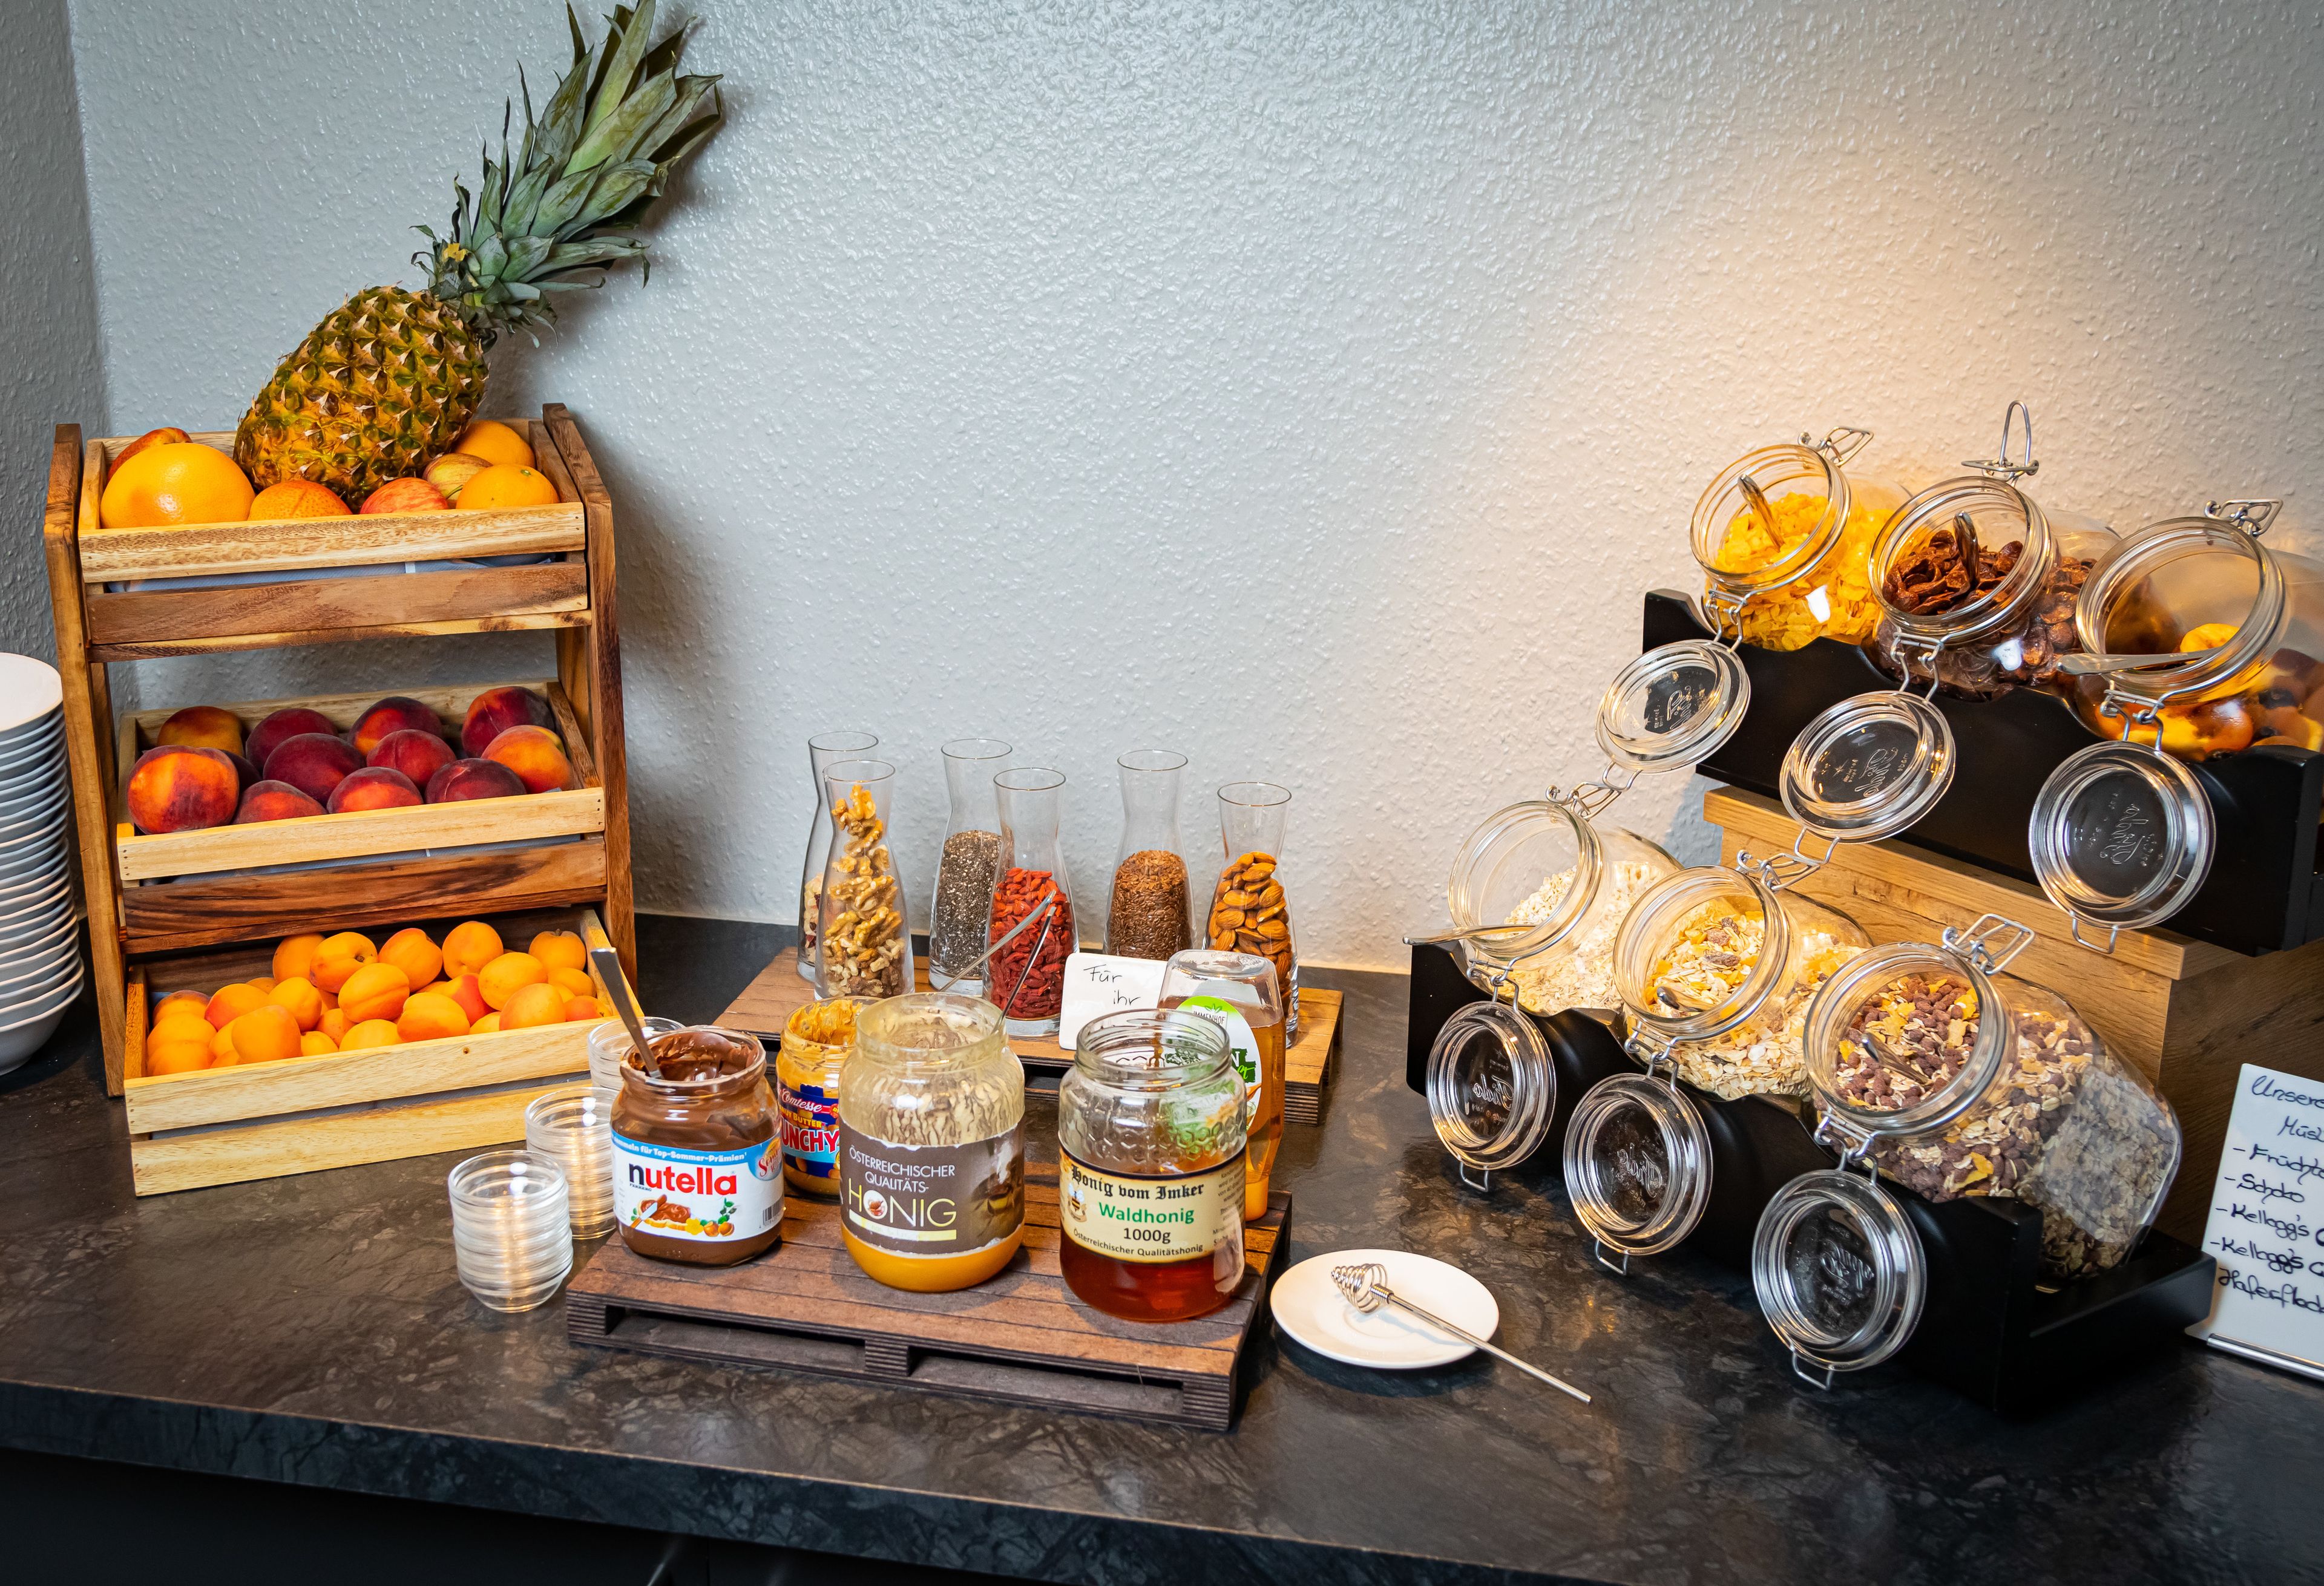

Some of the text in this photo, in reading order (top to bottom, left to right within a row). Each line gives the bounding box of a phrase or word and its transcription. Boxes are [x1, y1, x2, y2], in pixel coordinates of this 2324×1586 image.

[1112, 989, 1141, 1006] ihr
[782, 1089, 823, 1113] Comtesse
[781, 1116, 840, 1153] UNCHY
[849, 1144, 956, 1178] ÖSTERREICHISCHER
[629, 1163, 737, 1196] nutella
[865, 1171, 929, 1193] QUALITÄTS-
[1071, 1164, 1114, 1198] Honig
[1119, 1184, 1150, 1199] vom
[1155, 1184, 1204, 1200] Imker
[849, 1178, 957, 1227] HONIG
[1098, 1202, 1195, 1224] Waldhonig
[1073, 1228, 1203, 1257] Österreichischer Qualitätshonig
[1123, 1227, 1171, 1244] 1000g
